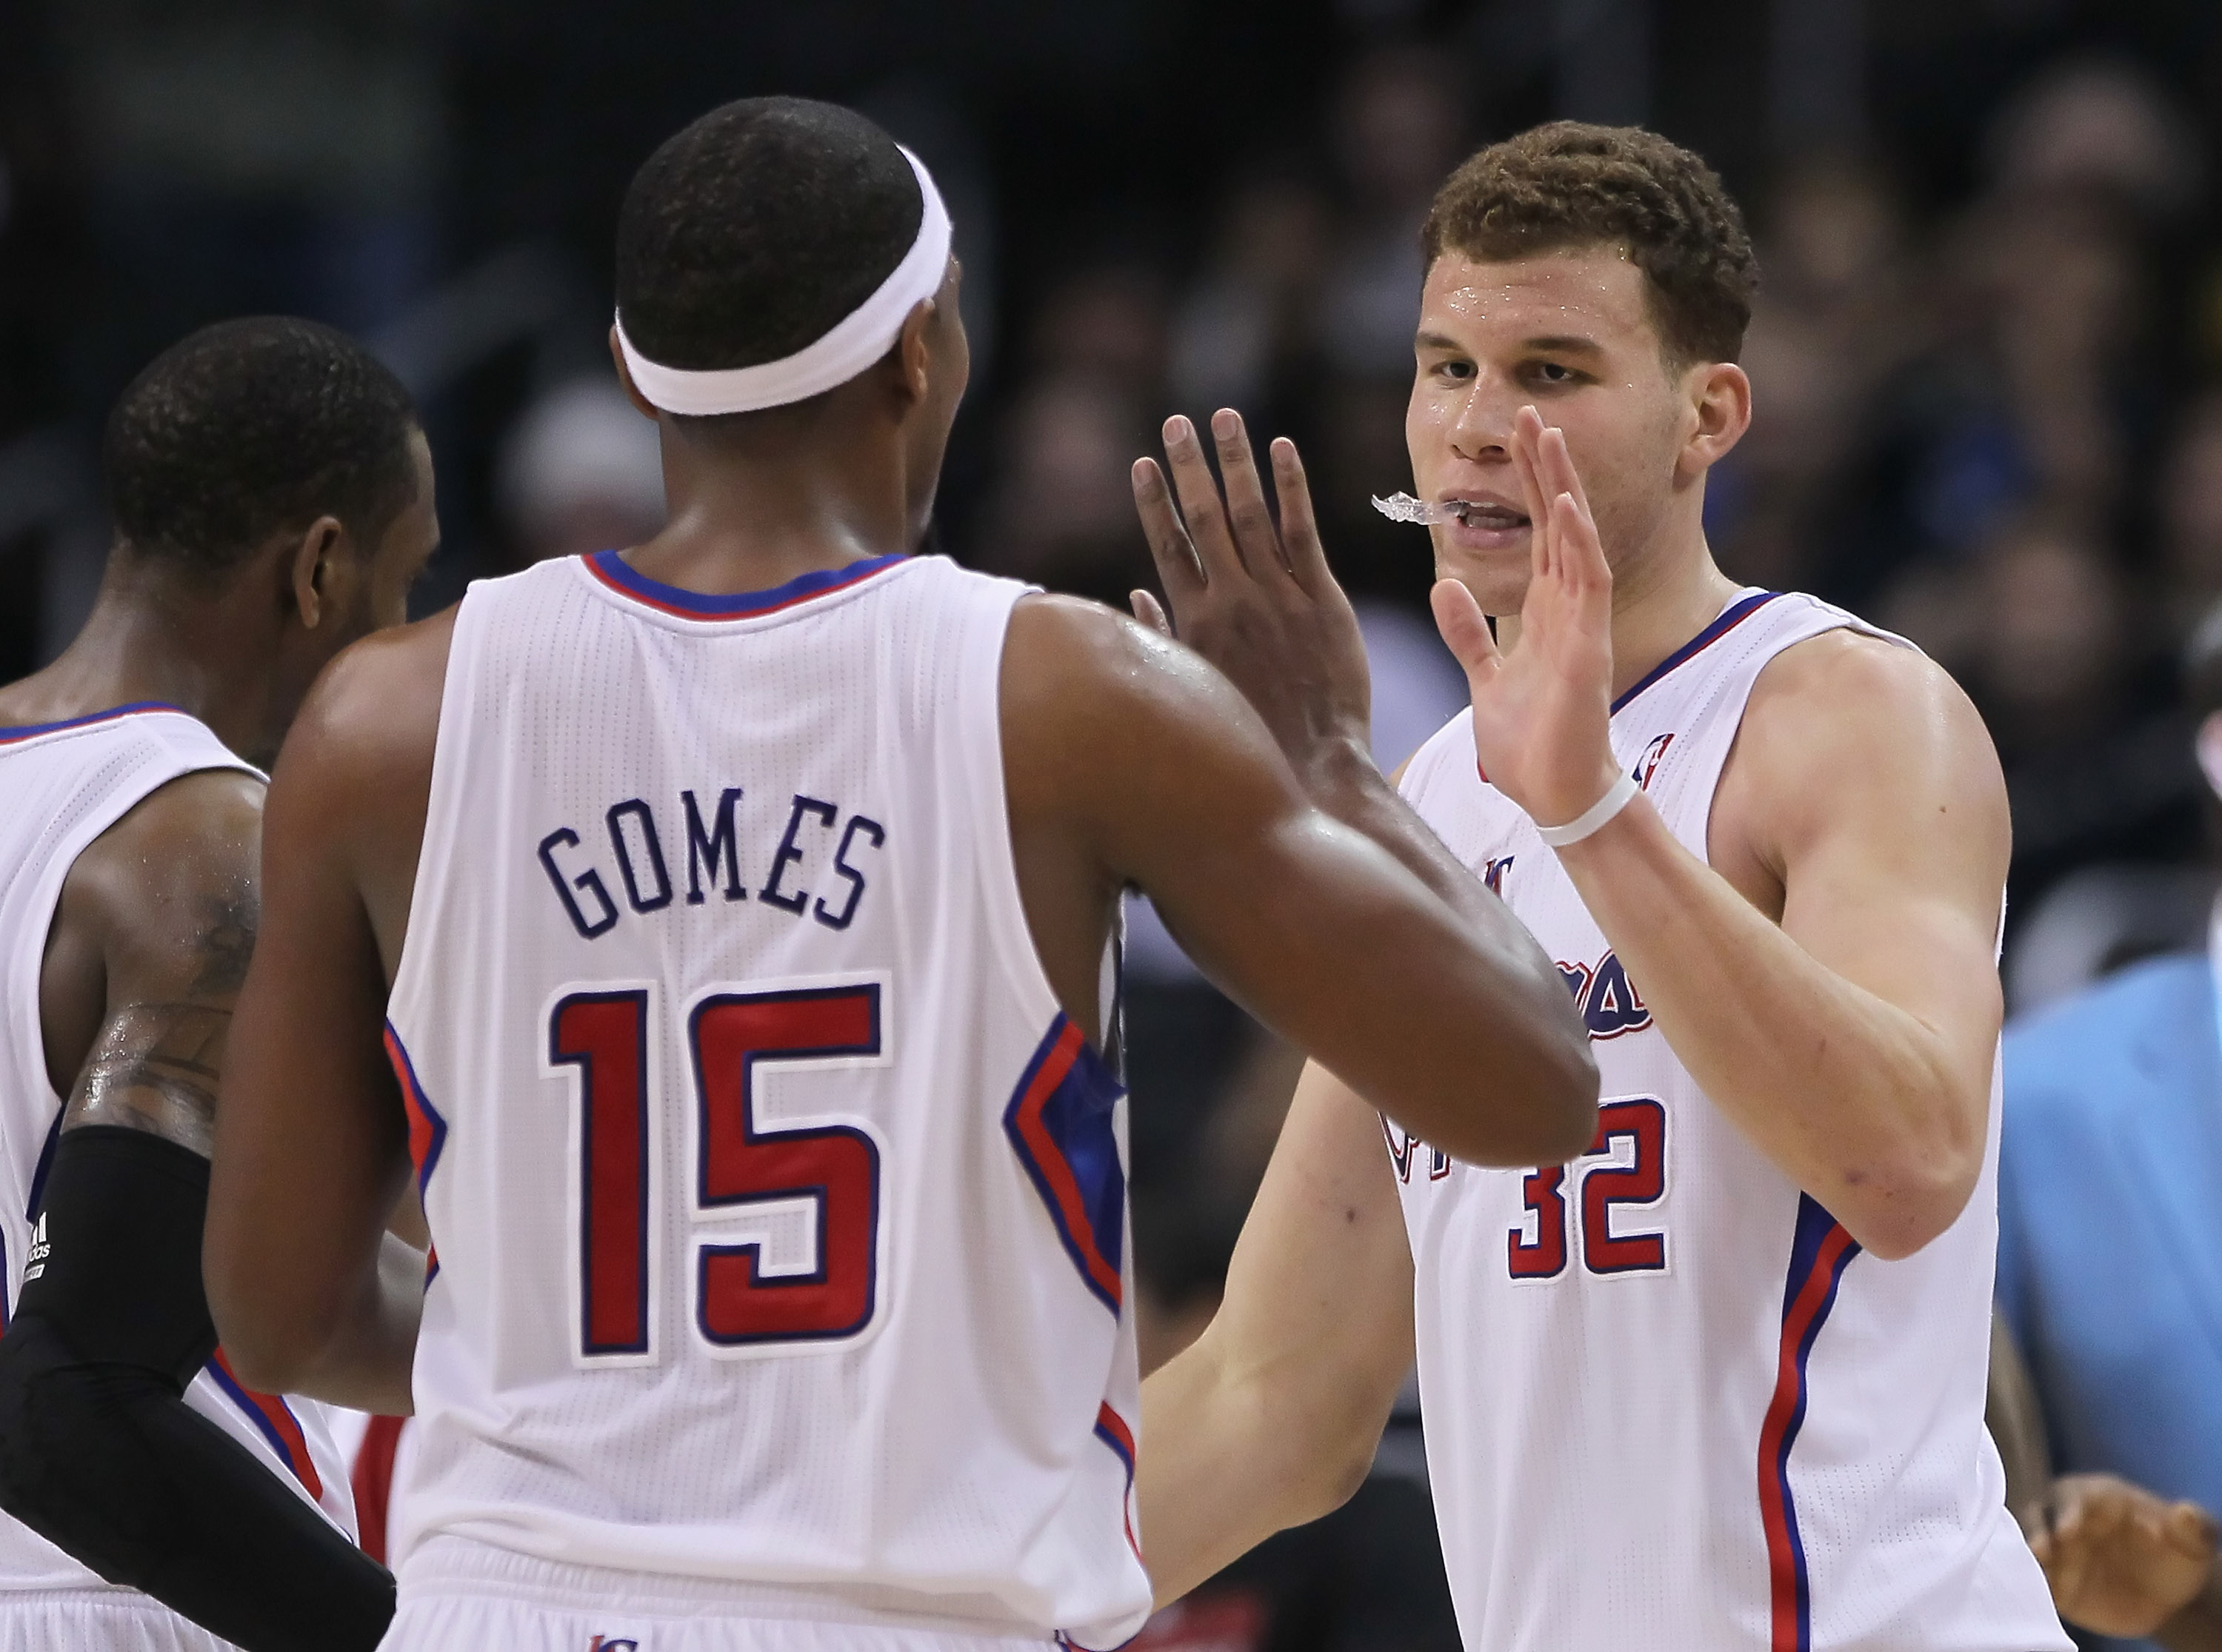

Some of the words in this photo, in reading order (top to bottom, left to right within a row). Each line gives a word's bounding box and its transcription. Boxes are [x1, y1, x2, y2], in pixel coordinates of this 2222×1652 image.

[537, 788, 885, 940] GOMES
[546, 980, 883, 1354] 15
[1507, 1097, 1667, 1280] 32
